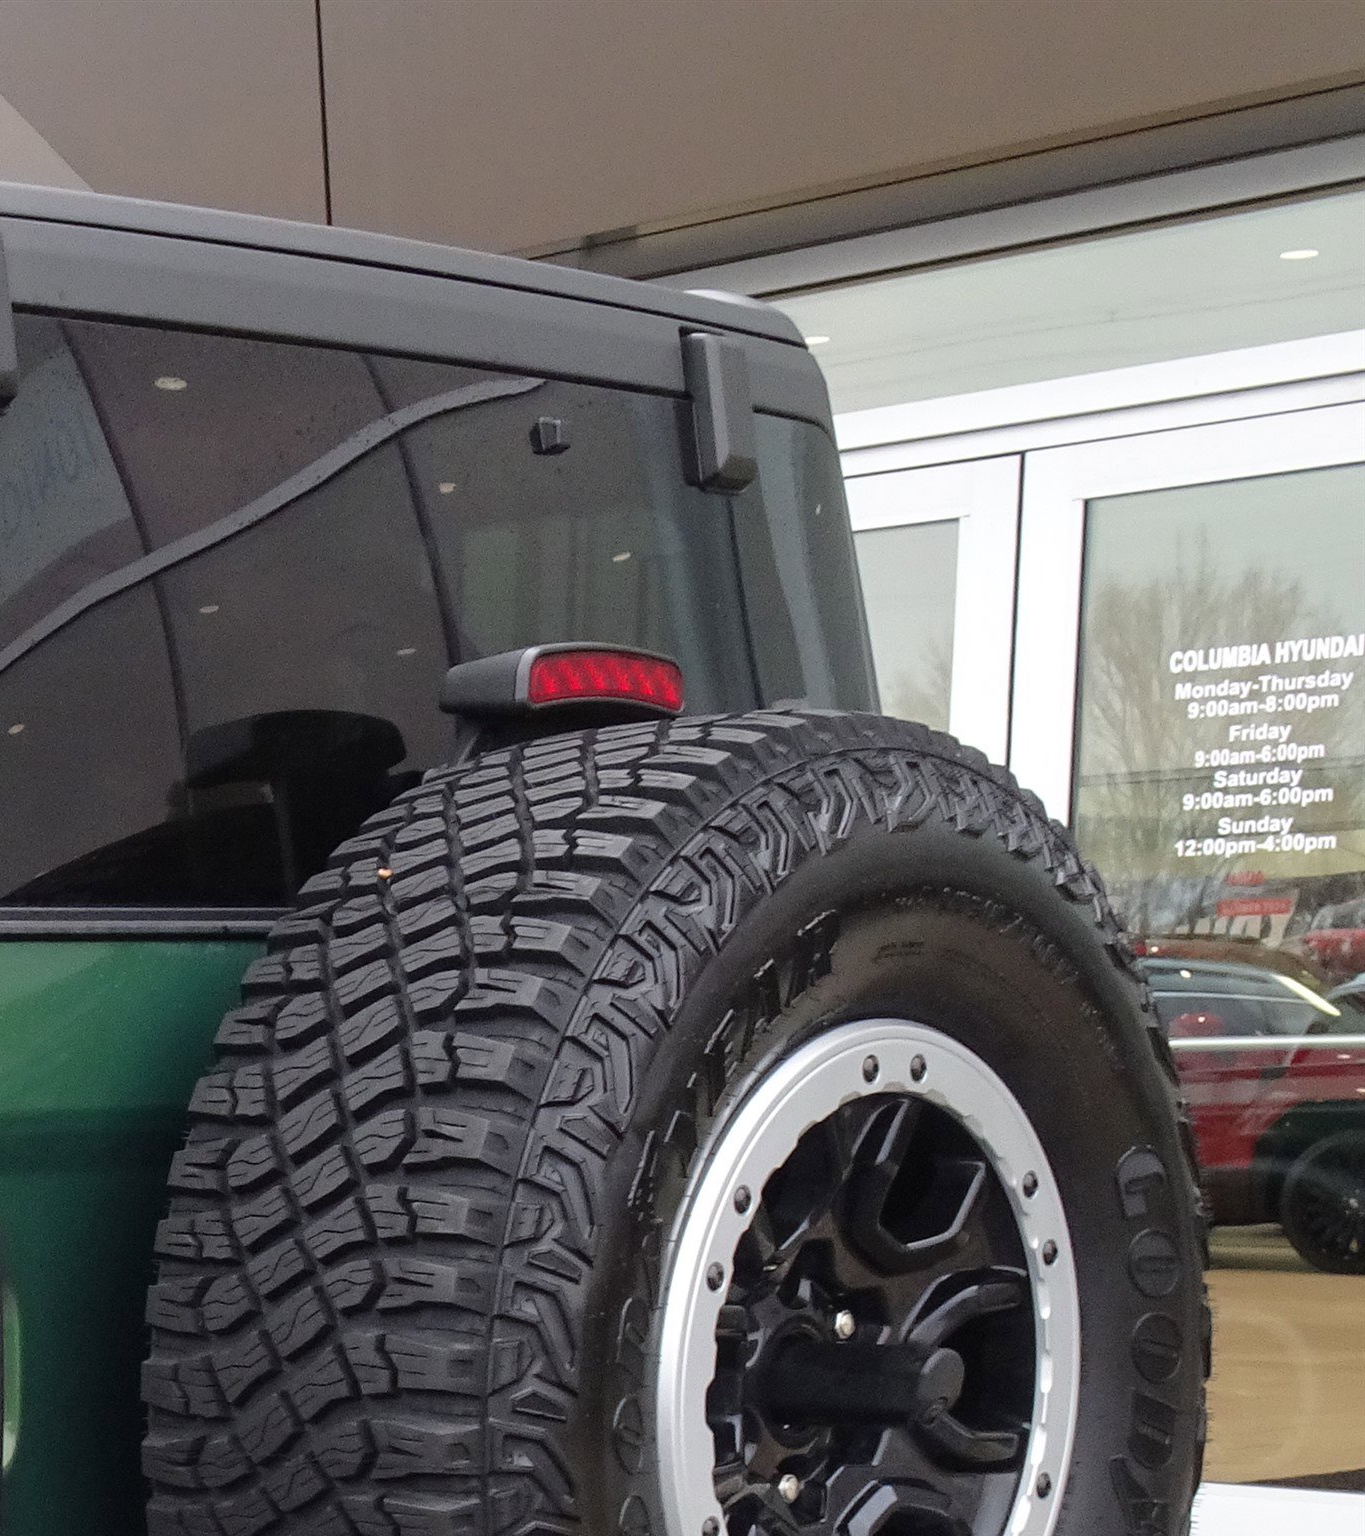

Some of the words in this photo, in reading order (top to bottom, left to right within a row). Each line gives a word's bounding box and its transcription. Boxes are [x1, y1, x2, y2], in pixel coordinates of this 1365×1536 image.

[1170, 643, 1271, 673] COLUMBIA
[1274, 634, 1365, 664] HYUNDAI
[1174, 670, 1354, 700] Monday-Thursday
[1187, 693, 1339, 719] 9:00am-8:00pm
[1229, 722, 1292, 743] Friday
[1194, 743, 1325, 768] 9:00am-6:00pm
[1213, 767, 1303, 788] Saturday
[1182, 786, 1334, 811] 9:00am-6:00pm
[1218, 816, 1294, 836] Sunday
[1174, 834, 1337, 858] 12:00pm-4:00pm
